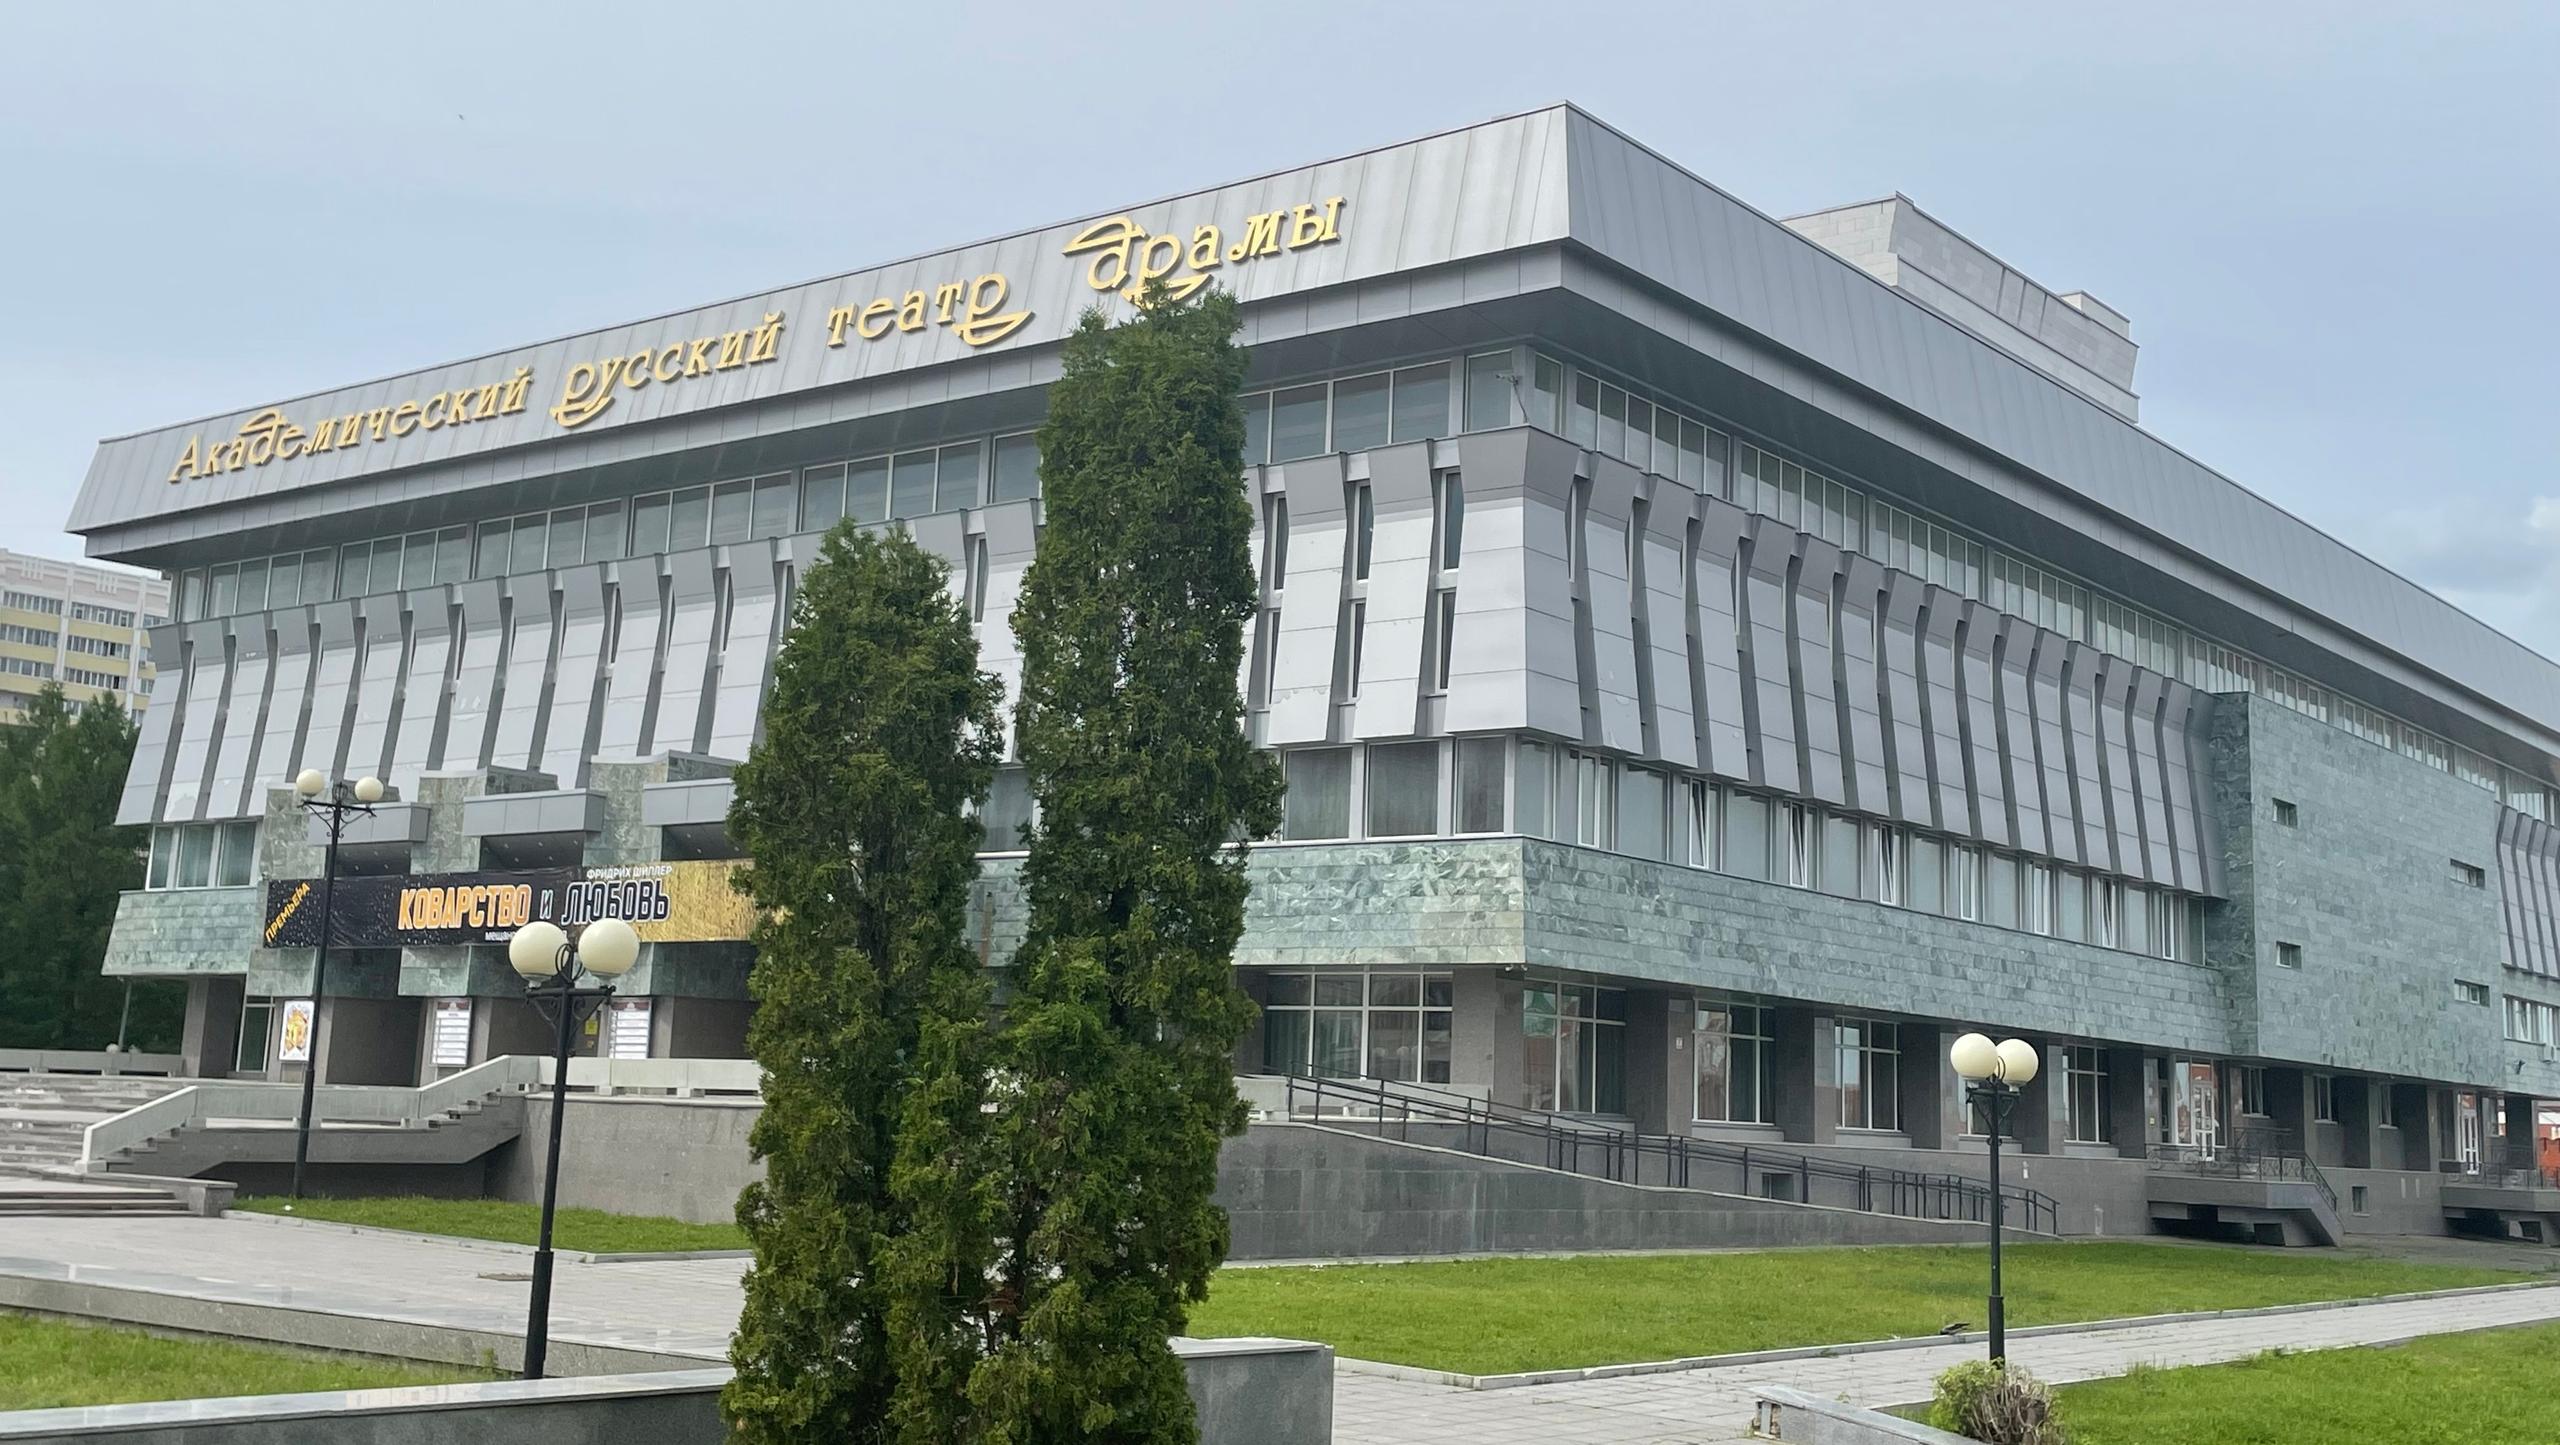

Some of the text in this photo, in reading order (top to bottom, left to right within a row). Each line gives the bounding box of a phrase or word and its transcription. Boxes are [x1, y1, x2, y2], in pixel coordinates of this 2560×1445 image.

[168, 196, 1346, 483] Академический русский театр драмы
[586, 865, 673, 880] ФРИДРИХ ШИЛЛЕР
[265, 882, 311, 943] ПРЕМЬЕРА
[398, 884, 532, 930] КОВАРСТВО
[561, 879, 671, 926] ЛЮБОВЬ
